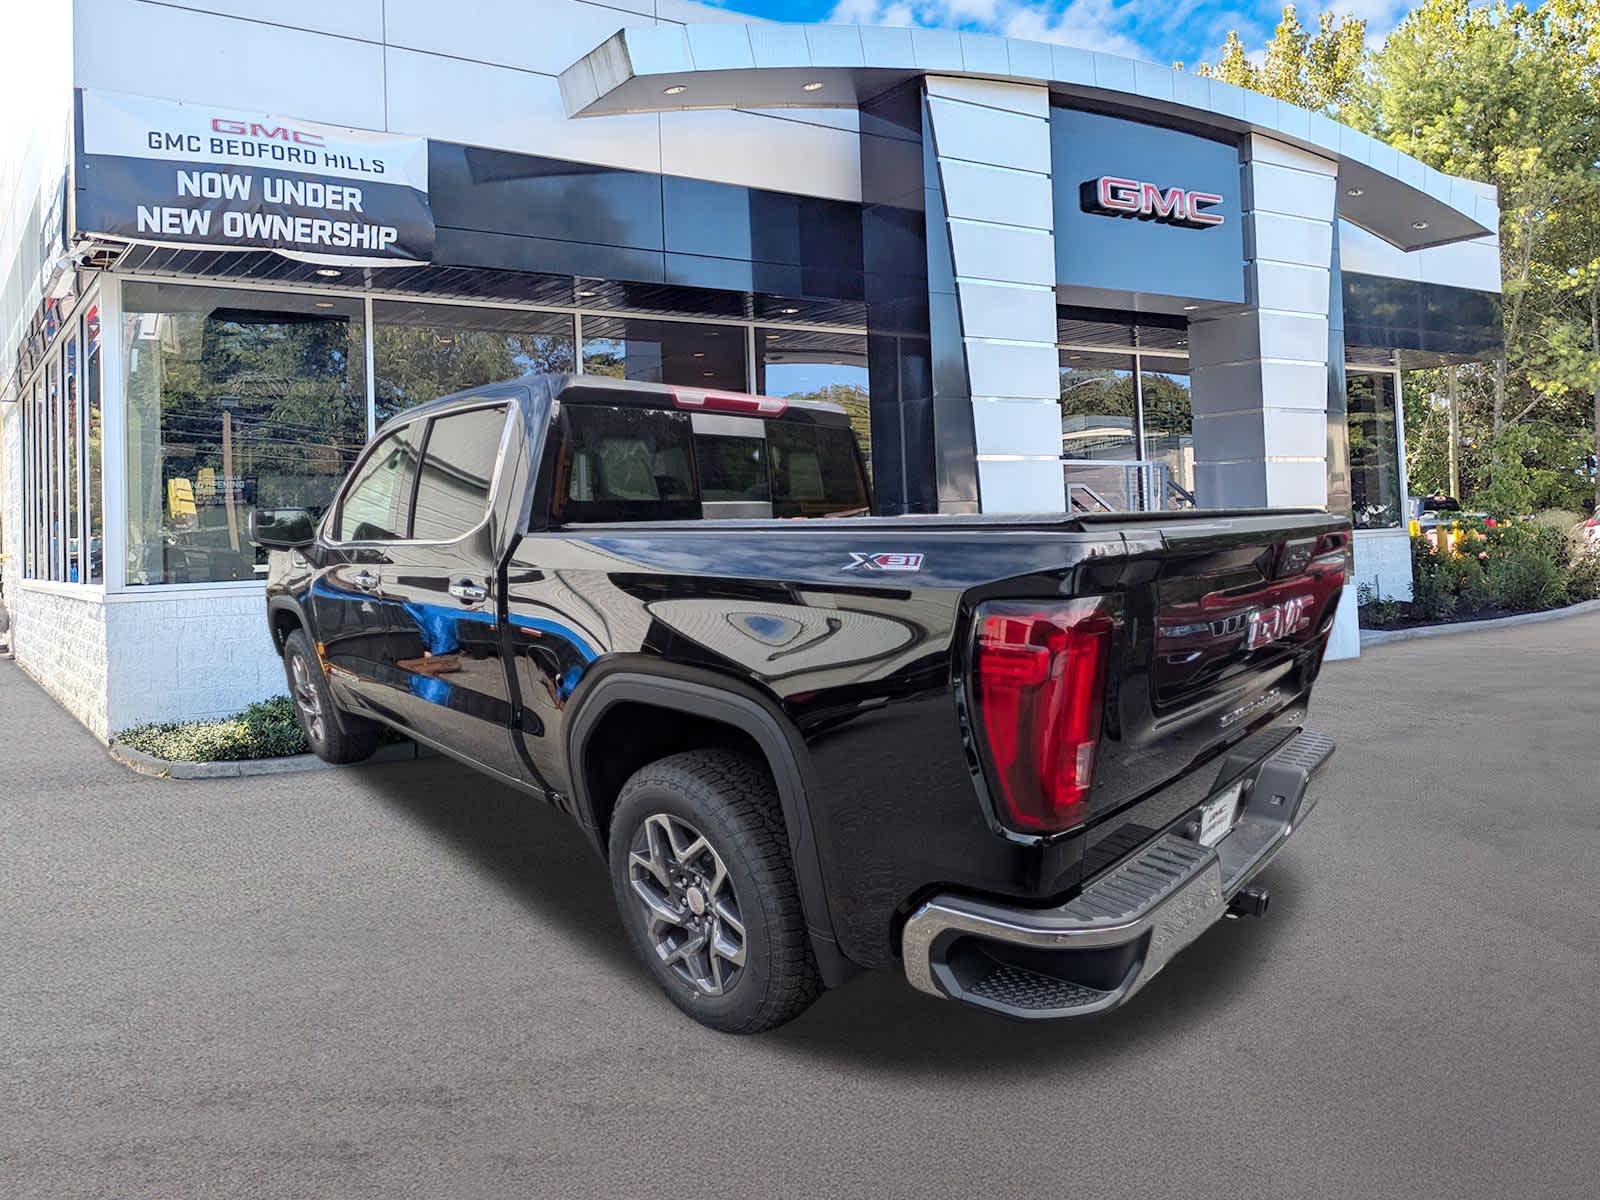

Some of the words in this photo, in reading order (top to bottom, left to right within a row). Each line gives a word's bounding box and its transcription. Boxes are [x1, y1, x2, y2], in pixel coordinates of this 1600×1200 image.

[147, 131, 201, 152] GMC
[209, 138, 317, 165] BEDFORD
[324, 152, 385, 174] HILLS
[211, 118, 325, 148] GMC
[177, 170, 253, 201] NOW
[263, 177, 364, 213] UNDER
[1099, 176, 1224, 224] GMC
[136, 205, 212, 236] NEW
[223, 211, 398, 250] OWNERSHIP
